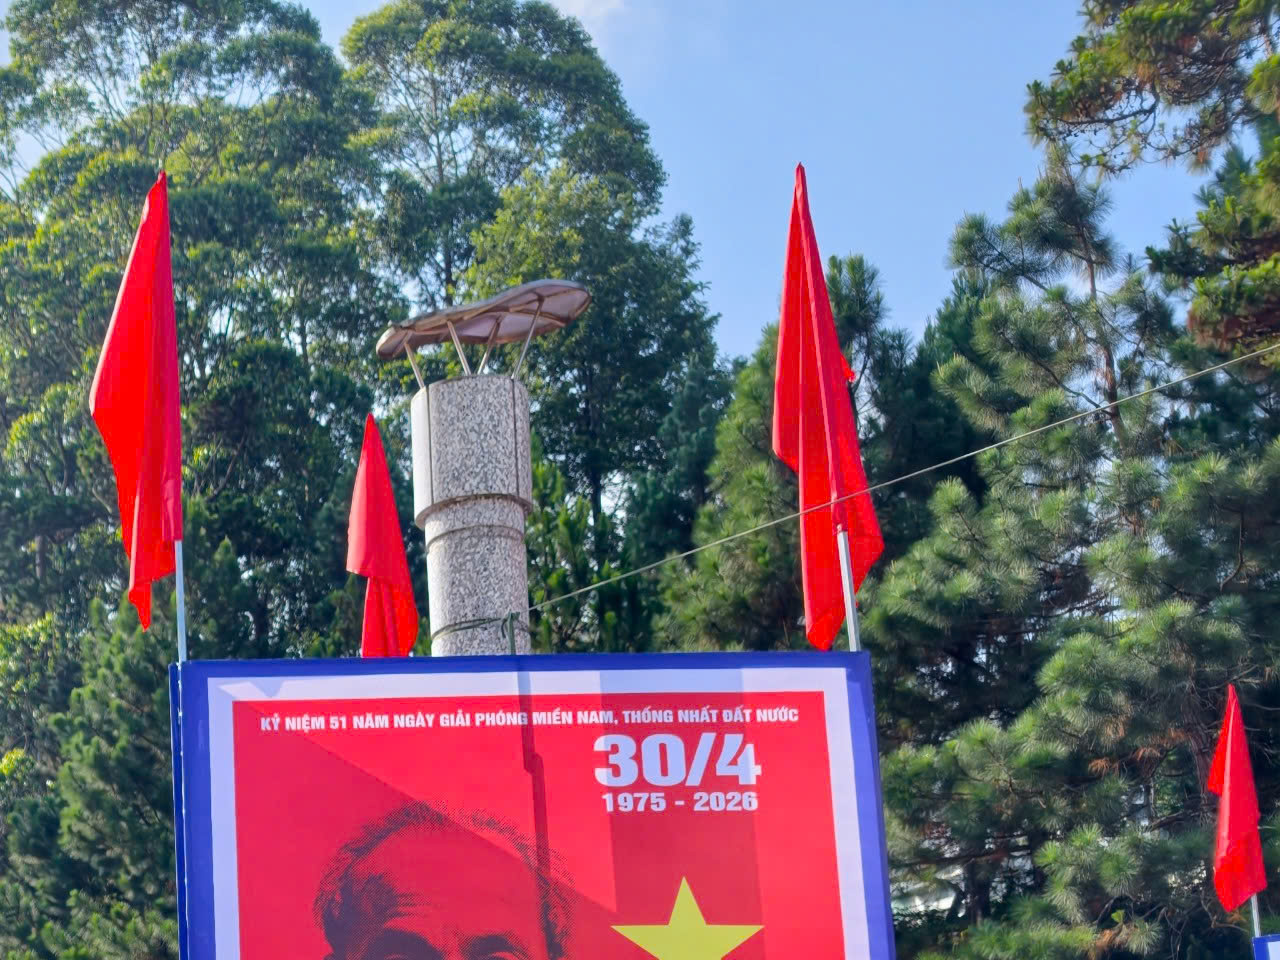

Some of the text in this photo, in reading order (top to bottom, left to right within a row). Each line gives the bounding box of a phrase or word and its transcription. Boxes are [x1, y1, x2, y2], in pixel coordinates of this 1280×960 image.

[285, 714, 325, 733] NIỆM
[330, 716, 348, 730] 51
[353, 712, 388, 729] NĂM
[394, 711, 434, 728] NGÀY
[439, 709, 470, 727] GIẢI
[475, 709, 528, 726] PHÓNG
[577, 710, 619, 725] NAM,
[623, 705, 673, 723] THỐNG
[677, 704, 717, 723] NHẤT
[722, 704, 752, 722] ĐẤT
[756, 704, 799, 722] NƯỚC
[593, 732, 762, 787] 30/4
[602, 792, 666, 812] 1975
[693, 791, 759, 811] 2026
